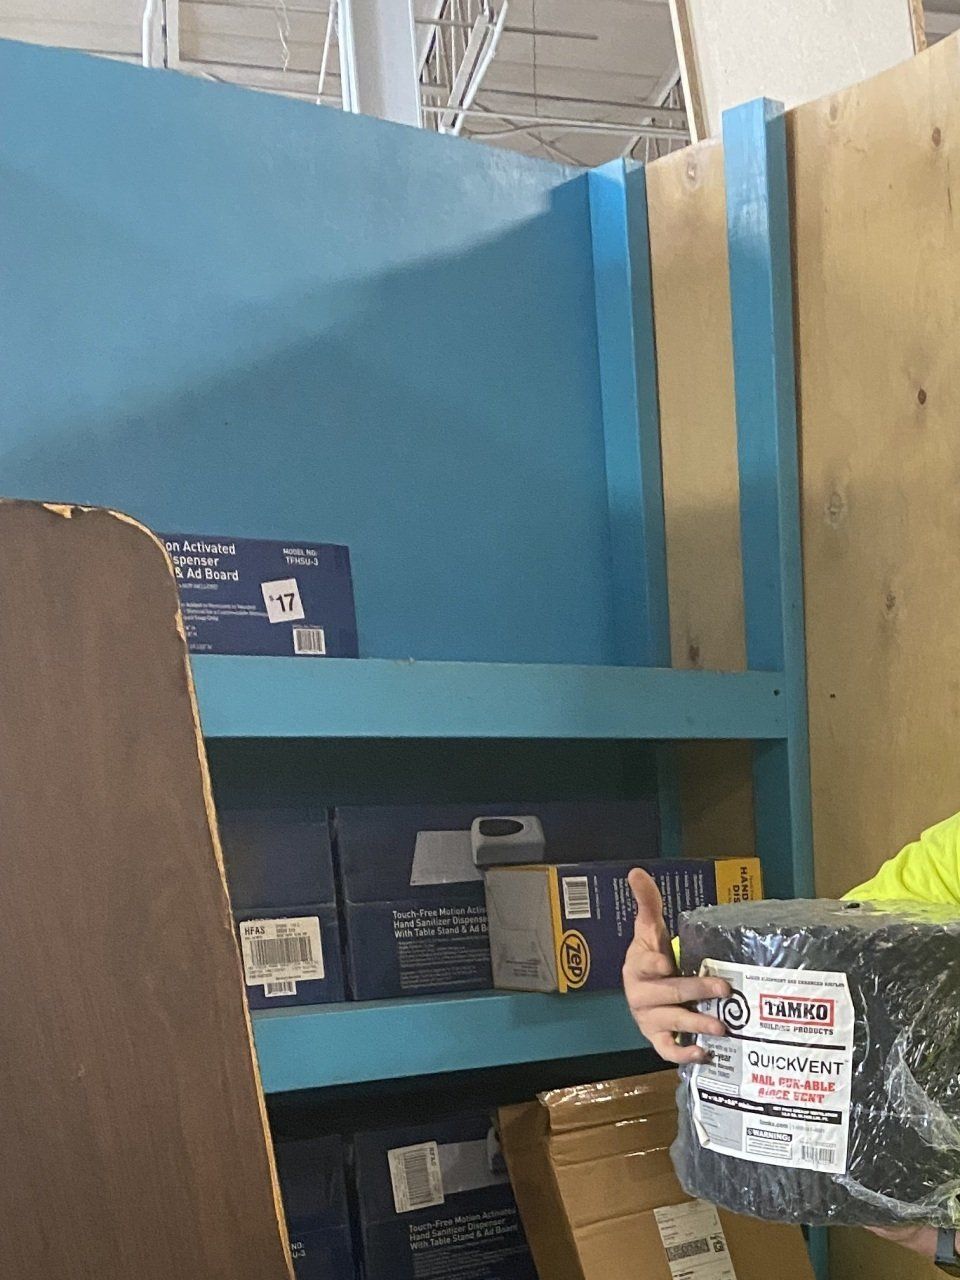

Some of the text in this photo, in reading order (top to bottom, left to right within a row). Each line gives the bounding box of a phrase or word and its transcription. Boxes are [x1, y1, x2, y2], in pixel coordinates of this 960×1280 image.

[183, 540, 236, 555] Activated
[174, 566, 239, 581] & Ad Board
[740, 866, 749, 901] HAND
[732, 884, 741, 904] DIS
[392, 908, 438, 919] Touch-Free
[440, 907, 466, 917] Motion
[393, 919, 414, 929] Hand
[416, 917, 450, 928] Sanitizer
[394, 929, 413, 938] With
[414, 927, 436, 938] Table
[437, 925, 459, 936] Stand
[461, 925, 467, 934] &
[469, 924, 480, 933] Ad
[564, 942, 583, 977] Zep
[764, 999, 829, 1020] TAMKO
[793, 1025, 834, 1036] PRODUCTS
[751, 1073, 775, 1087] NAIL
[793, 1091, 825, 1104] VENT
[409, 1219, 453, 1233] Touch-Free
[454, 1214, 481, 1224] Motion
[409, 1218, 505, 1241] Hand Sanitizer Dispenser
[409, 1240, 428, 1250] With
[430, 1236, 451, 1247] Table
[452, 1231, 475, 1243] Stand
[476, 1230, 482, 1238] &
[292, 1250, 306, 1258] U-3
